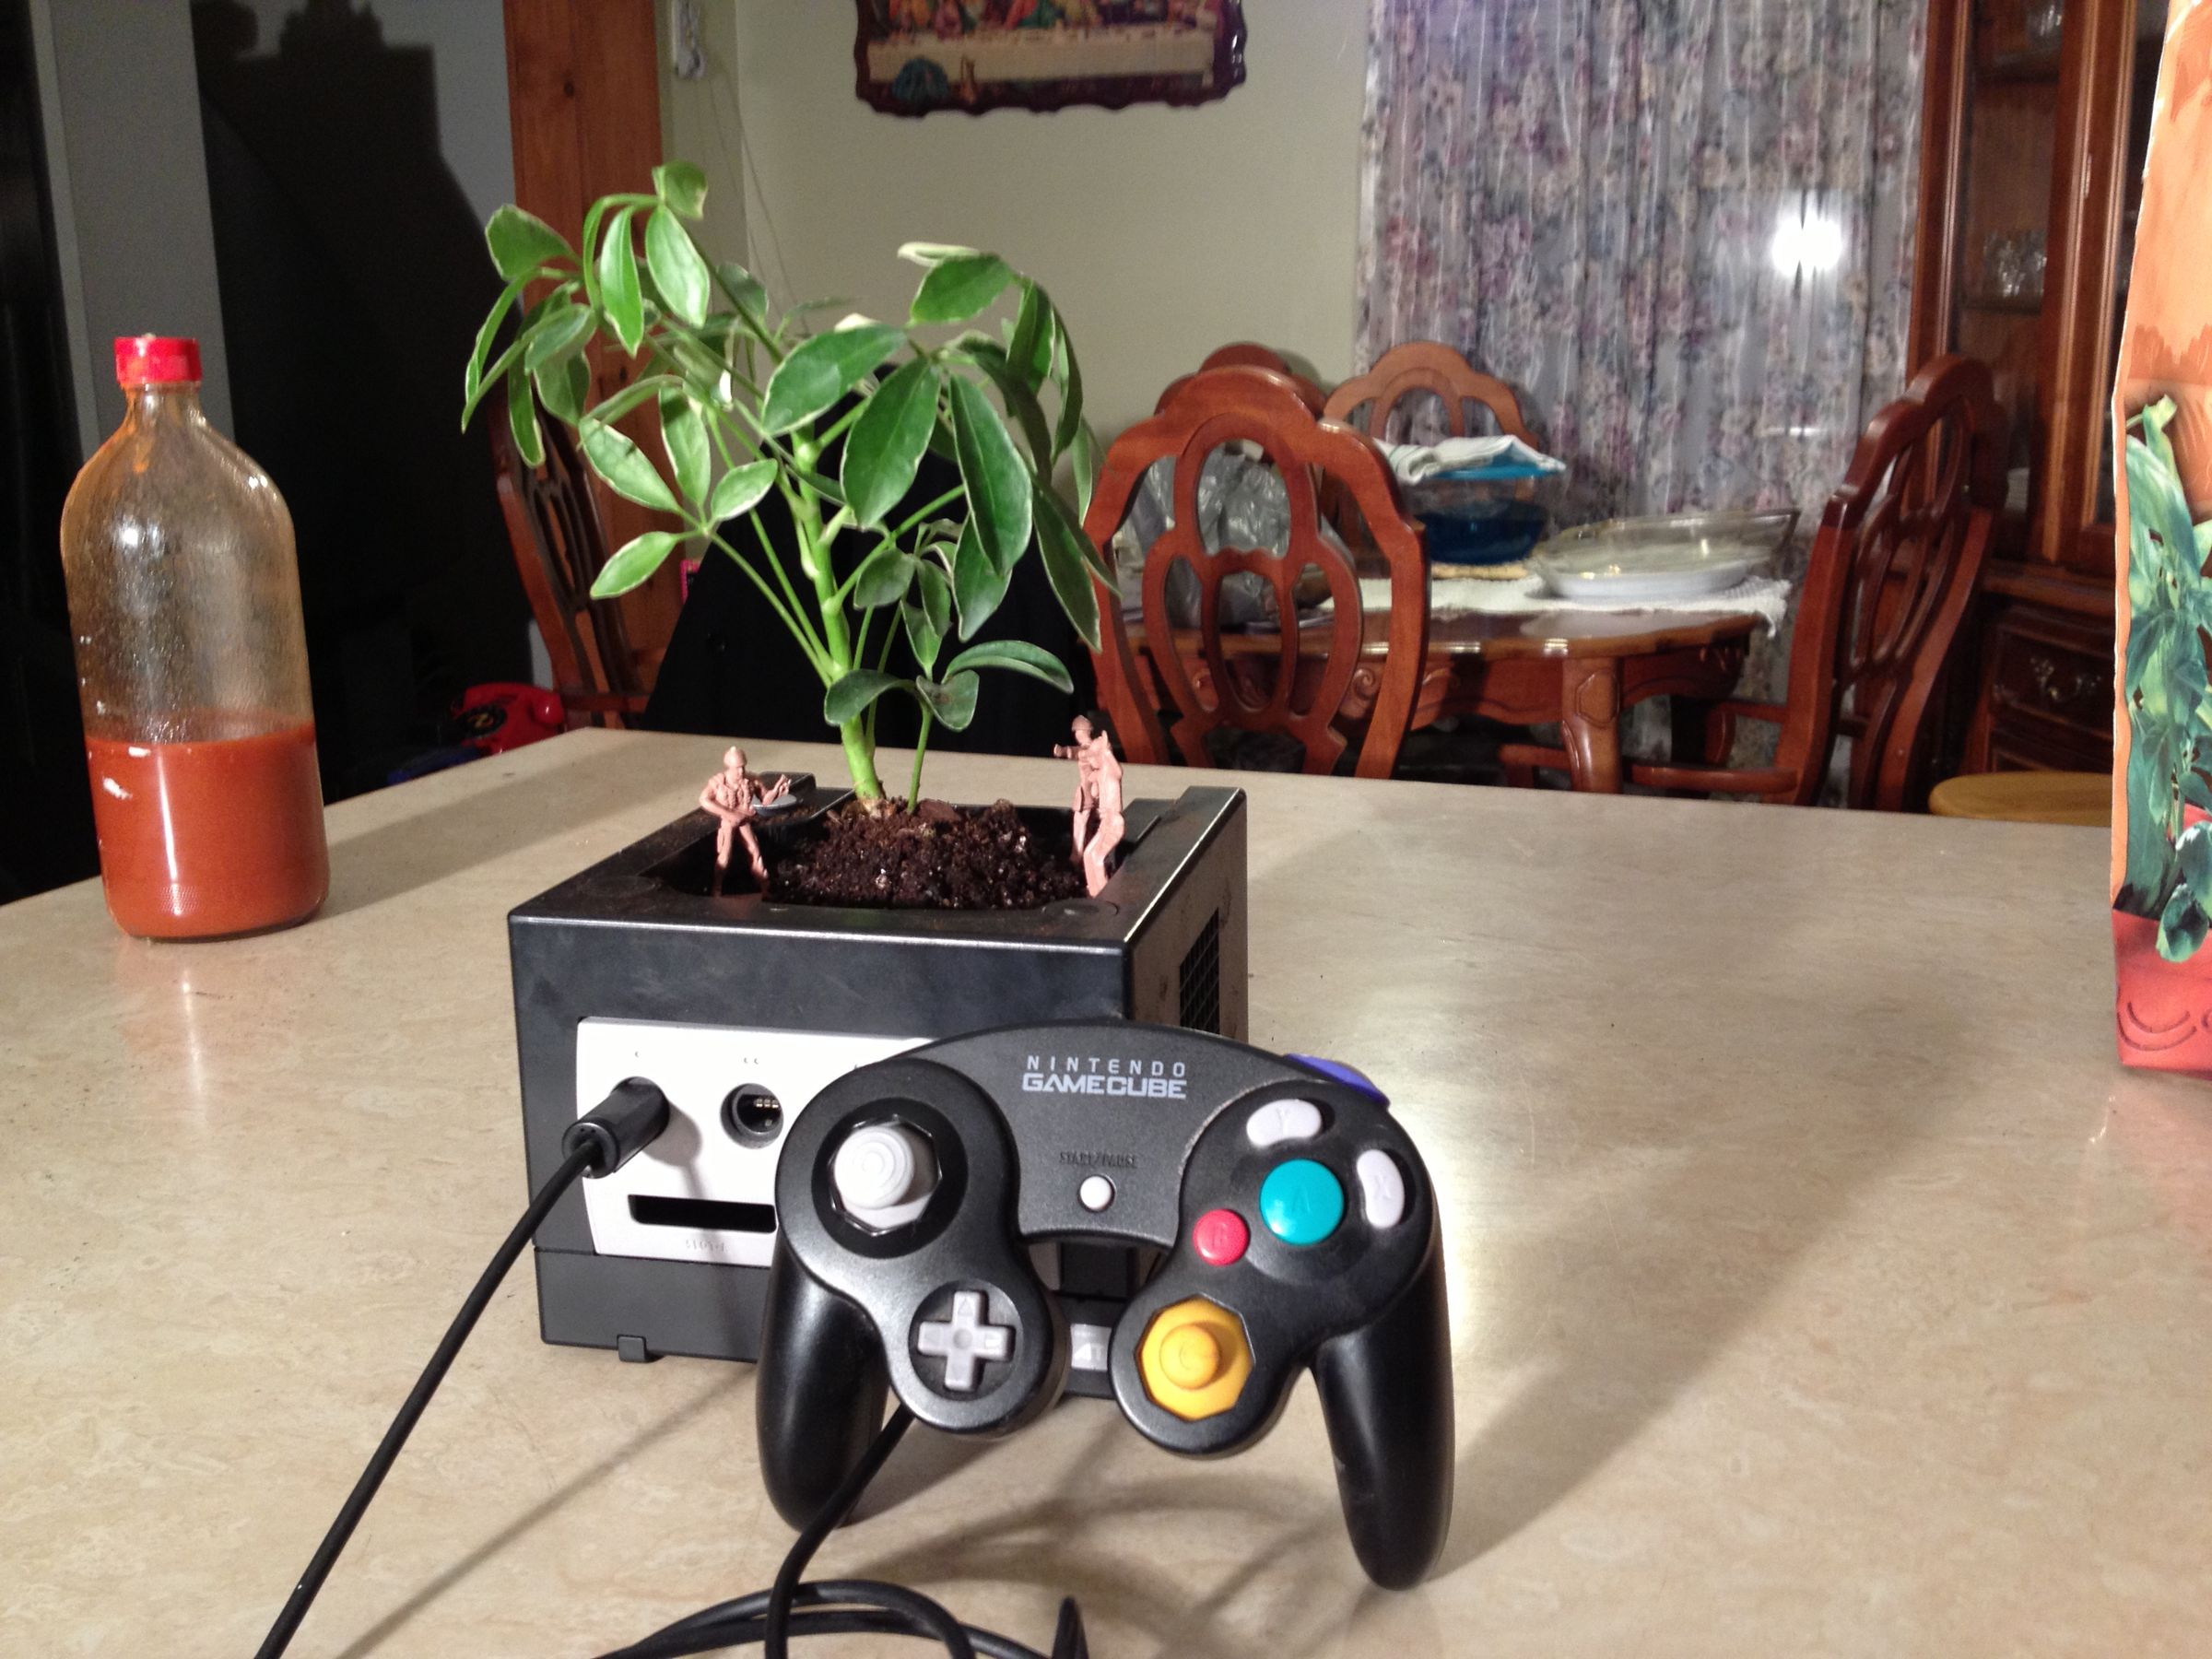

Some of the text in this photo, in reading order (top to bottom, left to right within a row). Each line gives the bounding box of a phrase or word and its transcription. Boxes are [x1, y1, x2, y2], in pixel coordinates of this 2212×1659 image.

[1027, 1055, 1186, 1077] NINTENDO
[1022, 1073, 1187, 1100] GAMECUBE
[1291, 1183, 1313, 1217] A
